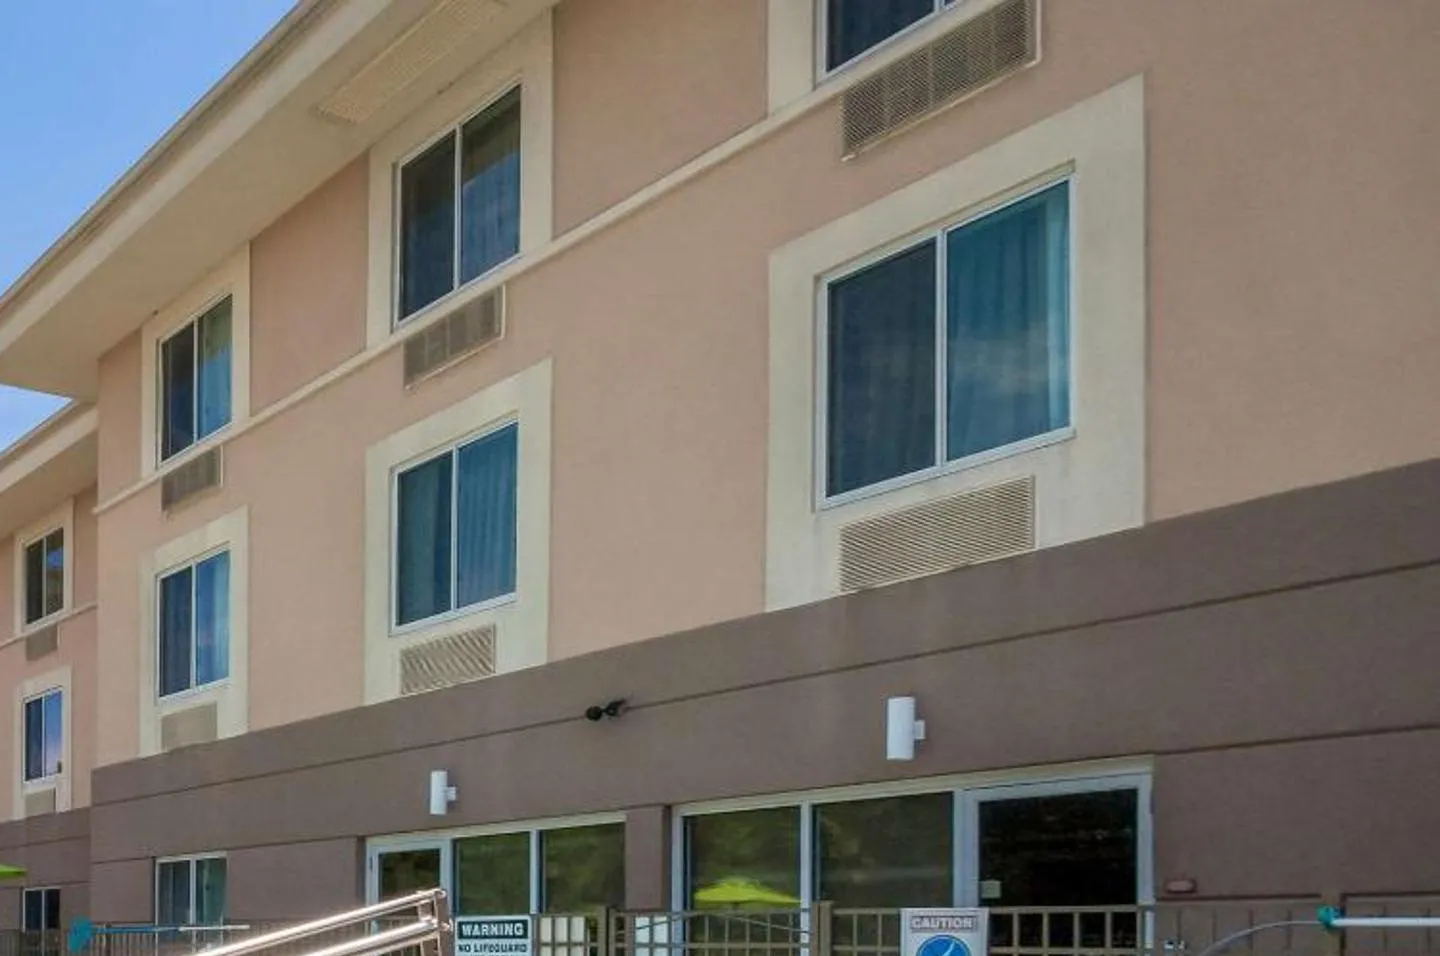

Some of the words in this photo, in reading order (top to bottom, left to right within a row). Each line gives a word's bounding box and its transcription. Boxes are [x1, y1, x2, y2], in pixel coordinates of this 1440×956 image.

[911, 917, 973, 929] CAUTION
[462, 923, 524, 937] WARNING
[458, 944, 471, 953] NO
